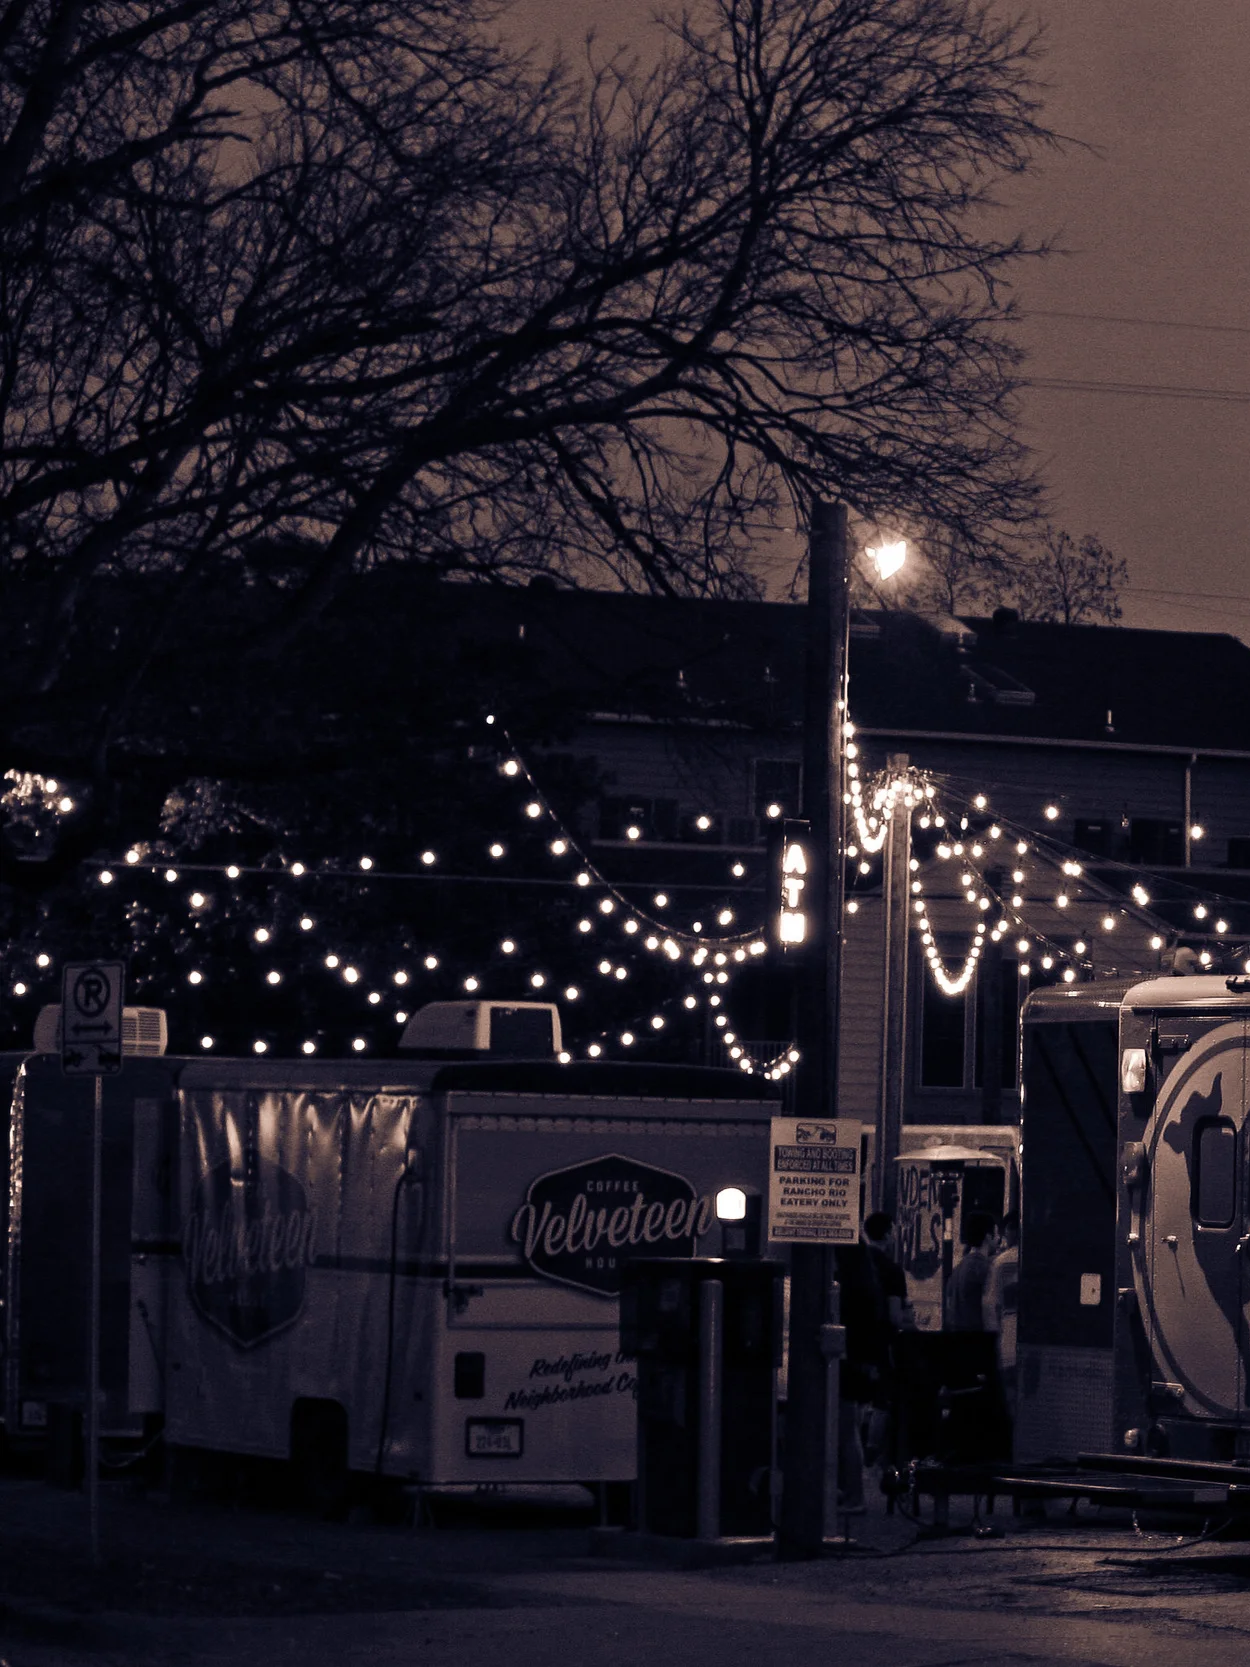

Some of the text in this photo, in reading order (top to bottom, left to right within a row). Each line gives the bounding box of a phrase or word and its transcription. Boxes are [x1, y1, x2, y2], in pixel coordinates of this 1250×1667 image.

[586, 1180, 640, 1193] COFFEE
[779, 1176, 850, 1186] PARKING FOR
[783, 1187, 847, 1197] RANCHO RIO
[780, 1198, 848, 1208] EATERY ONLY
[511, 1192, 713, 1259] Velveteen
[585, 1257, 617, 1269] HOU
[529, 1350, 612, 1382] Redefining
[504, 1375, 616, 1411] Neighborhood
